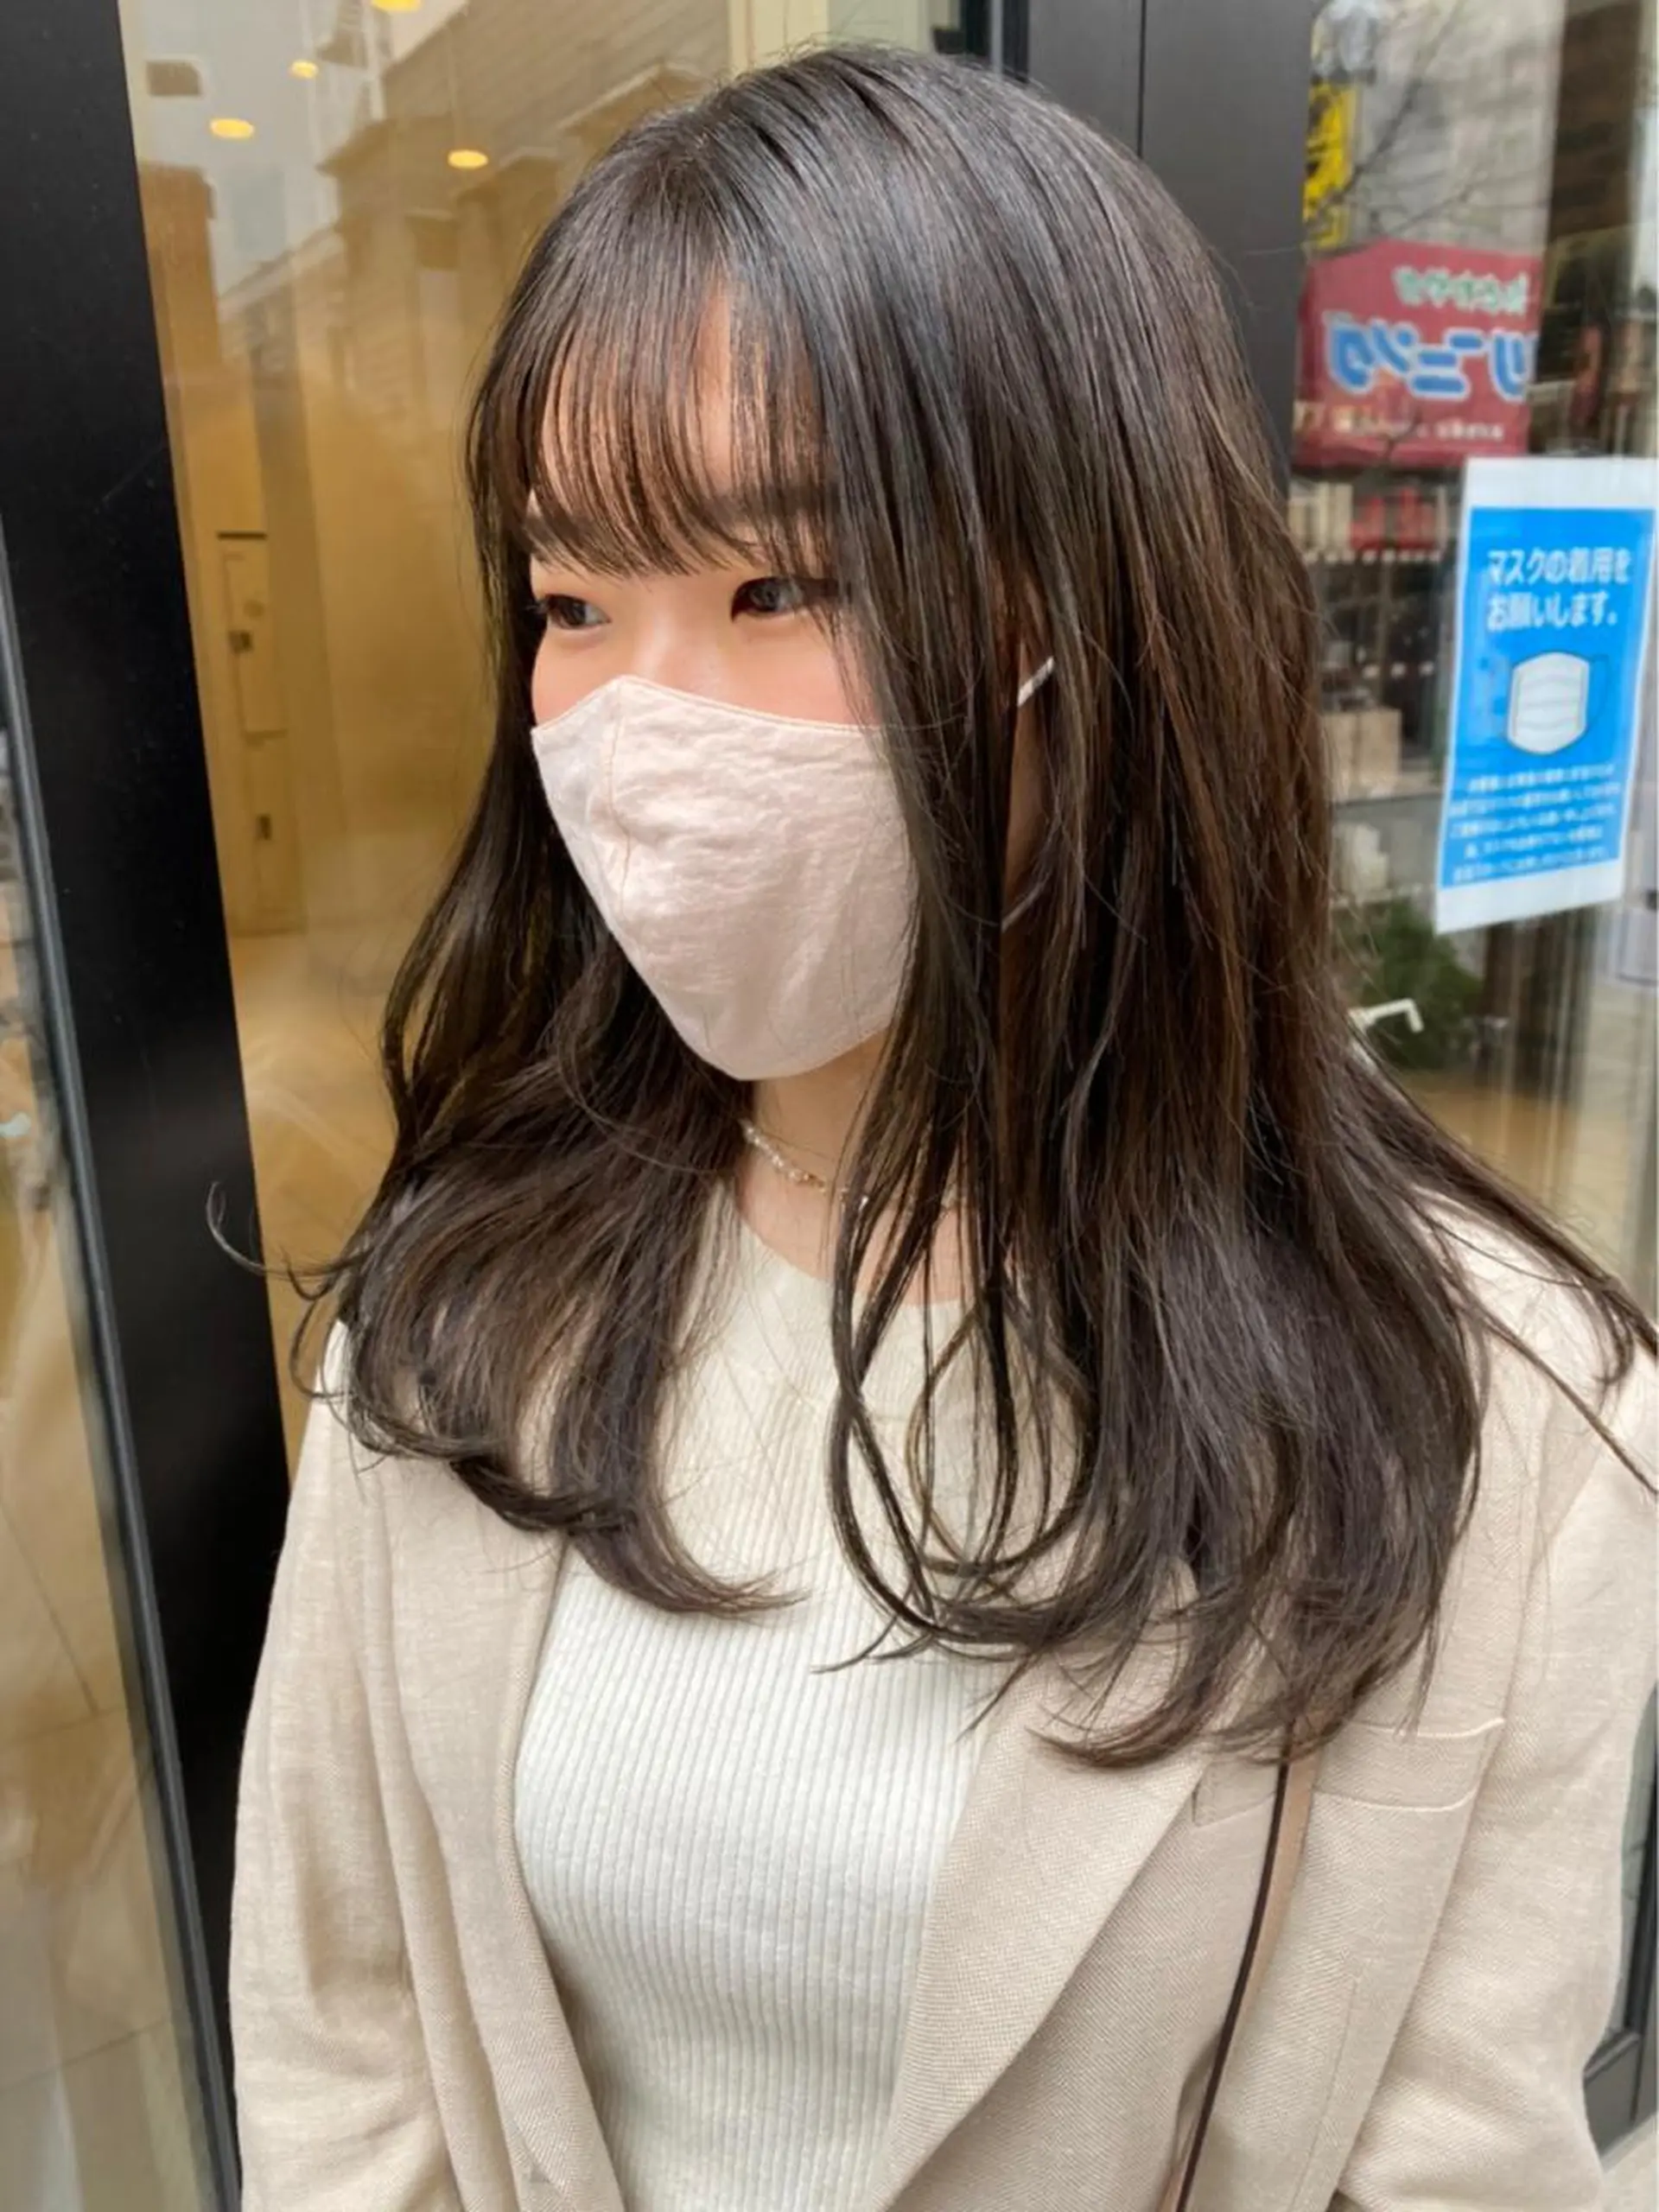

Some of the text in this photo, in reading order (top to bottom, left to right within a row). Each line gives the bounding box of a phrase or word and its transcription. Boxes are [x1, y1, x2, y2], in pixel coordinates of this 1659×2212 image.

[1487, 547, 1631, 587] マスクの着用を
[1487, 590, 1618, 632] お願いします。
